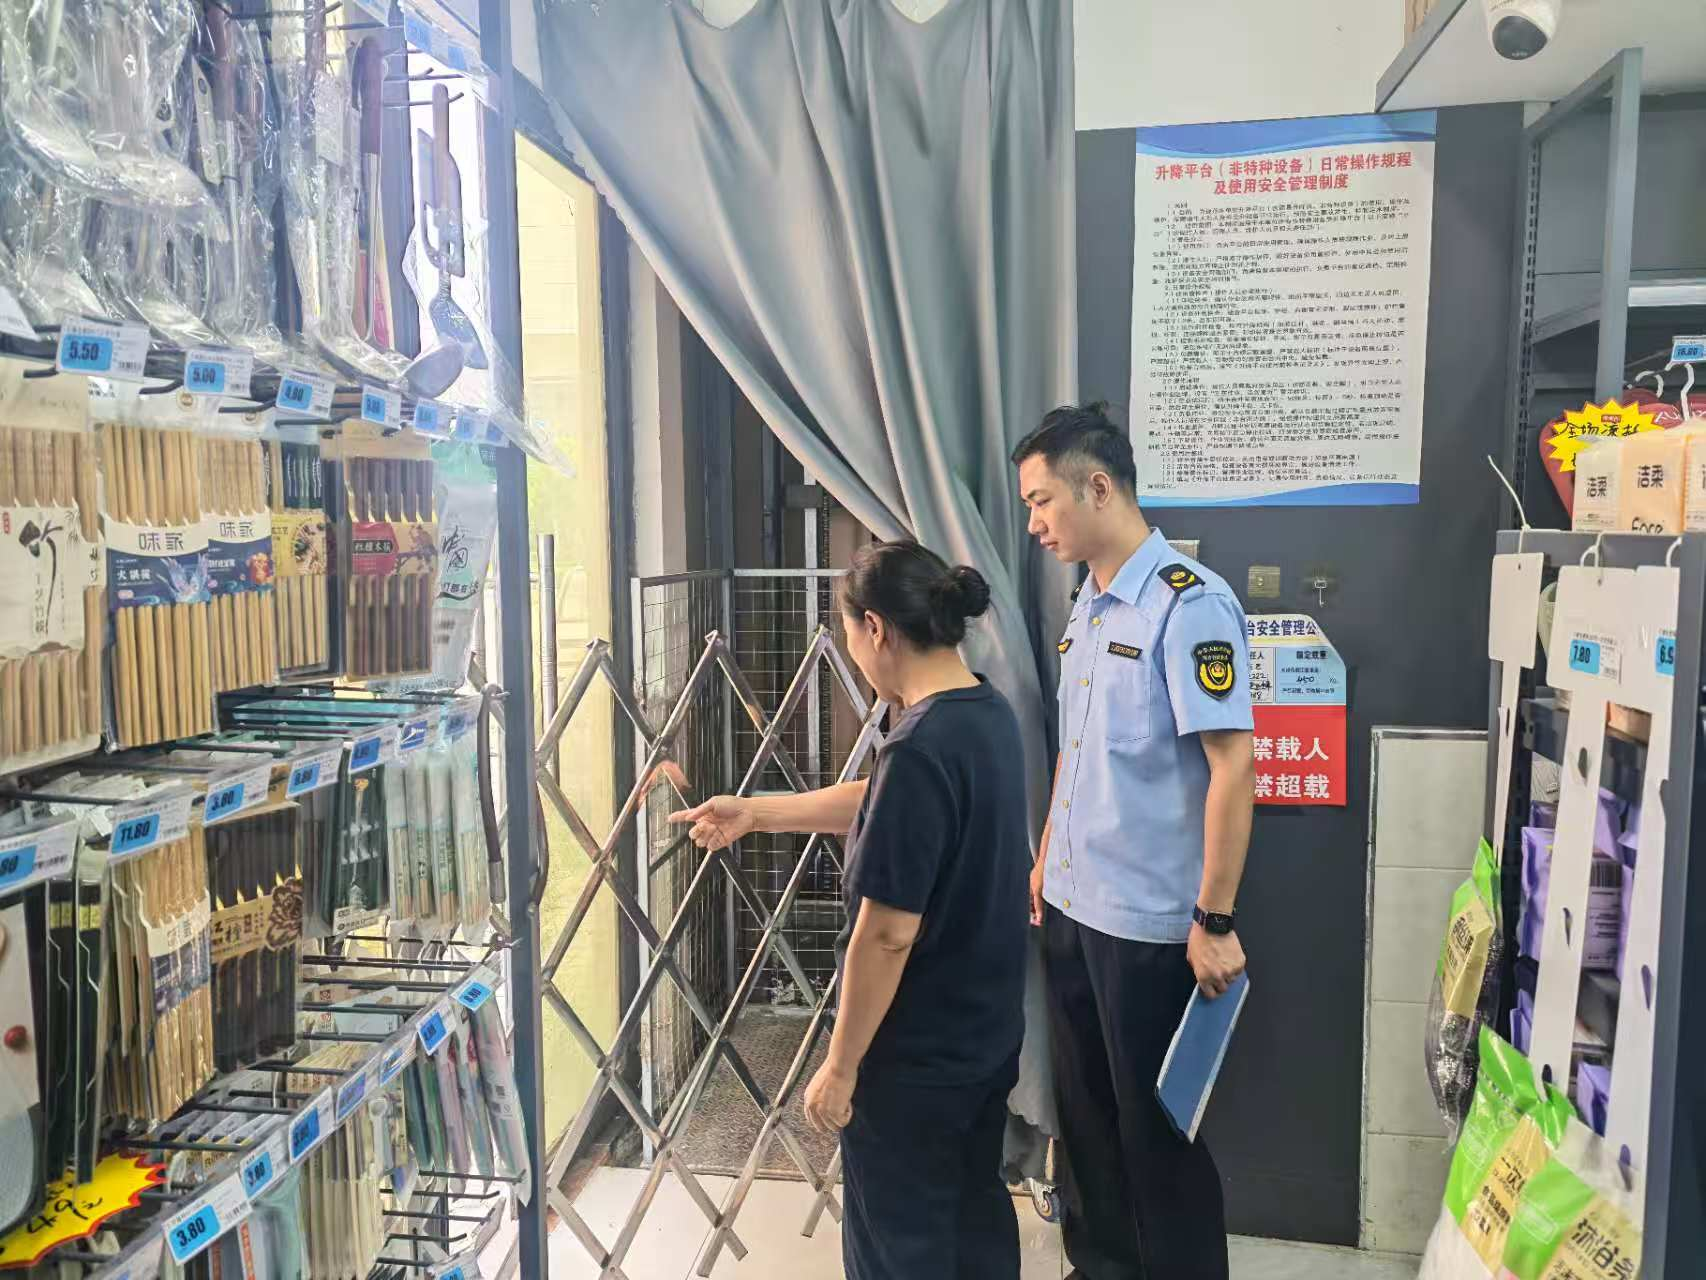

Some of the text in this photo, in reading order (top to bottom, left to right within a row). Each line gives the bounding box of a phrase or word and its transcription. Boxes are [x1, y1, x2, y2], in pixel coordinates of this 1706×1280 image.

[1214, 174, 1349, 196] 及使用安全管理制度
[68, 340, 99, 361] 5.50
[1587, 476, 1608, 497] 洁柔
[1637, 464, 1664, 488] 洁柔
[219, 521, 255, 538] 味家
[138, 532, 184, 551] 味家
[120, 822, 150, 847] 11.80
[177, 1216, 207, 1245] 3.80
